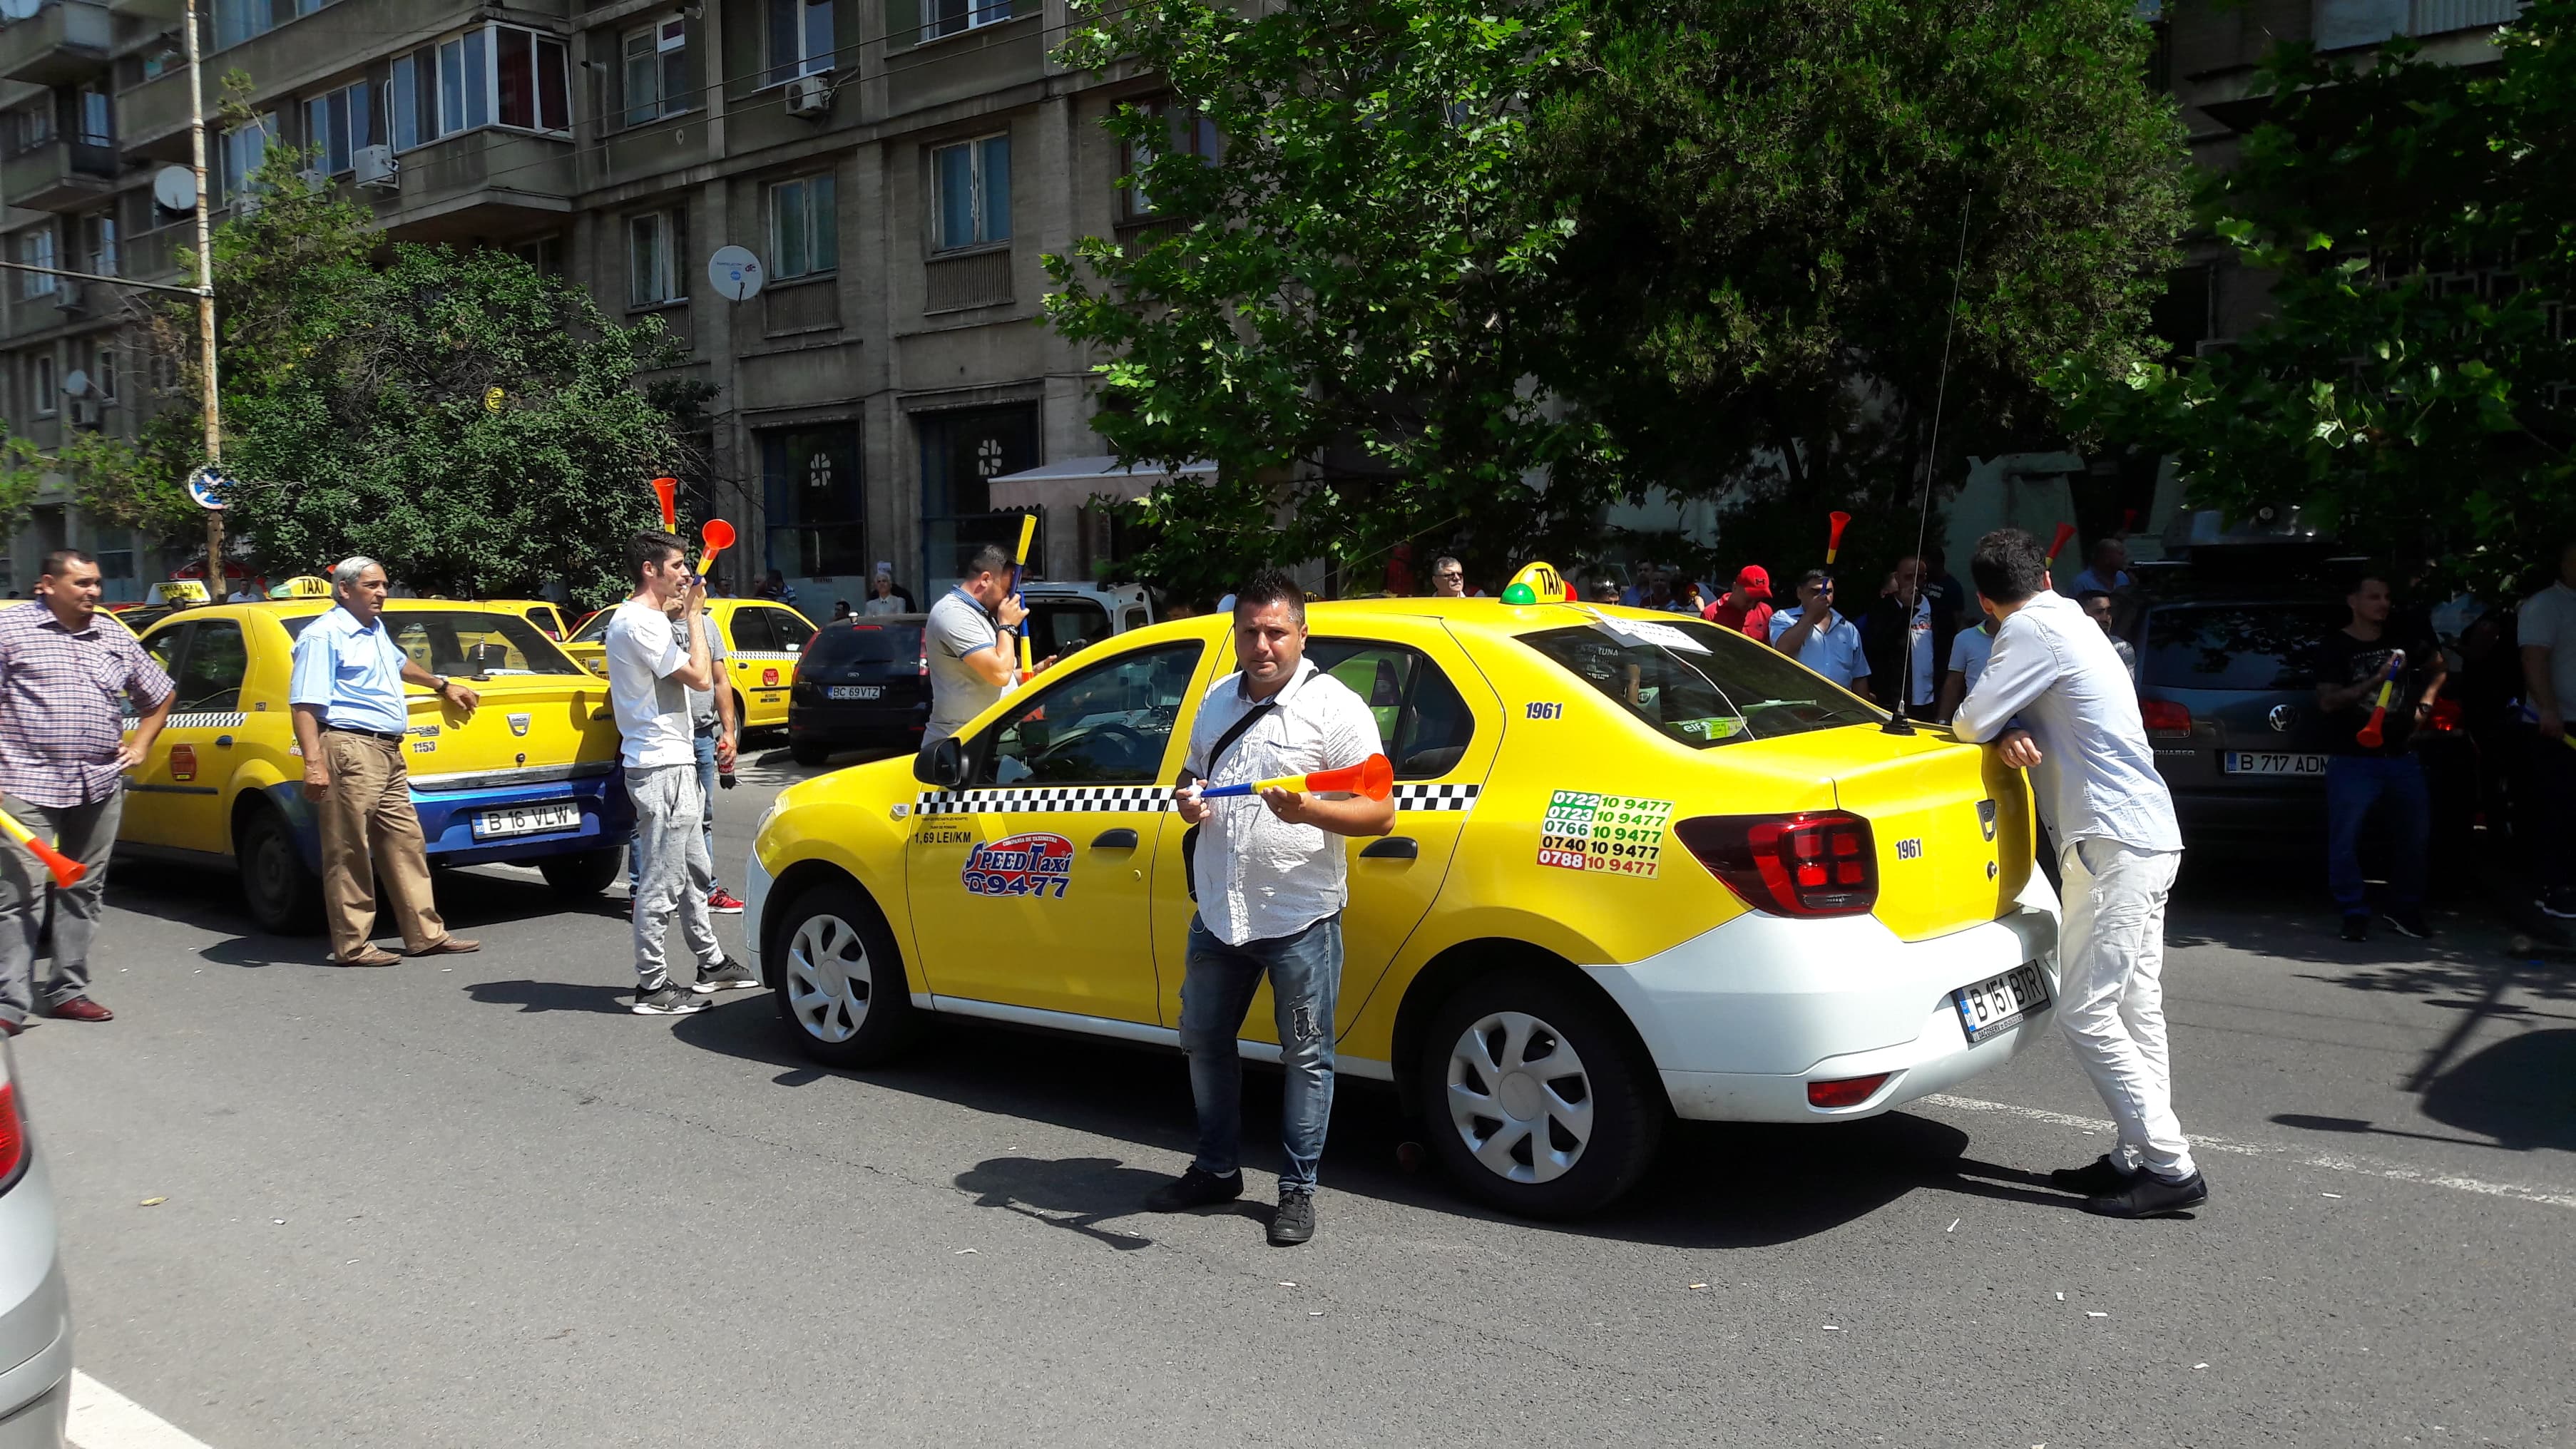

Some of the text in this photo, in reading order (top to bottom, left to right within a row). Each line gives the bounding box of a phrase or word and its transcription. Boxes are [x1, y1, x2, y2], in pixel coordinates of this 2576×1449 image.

[299, 578, 324, 594] TAXI
[1534, 567, 1564, 595] TAXI
[833, 687, 847, 697] BC
[1525, 702, 1563, 720] 1961
[412, 741, 436, 753] 1153
[2241, 754, 2254, 771] B
[2261, 754, 2290, 772] 717
[1553, 792, 1672, 812] 0722 10 9477
[488, 806, 568, 831] B 16 VLW
[1548, 806, 1665, 826] 0723 10 9477
[915, 831, 971, 844] 1,69 LEI/KM
[1545, 821, 1662, 844] 0766 10 9477
[1543, 836, 1660, 860] 0740 10 9477
[1896, 838, 1922, 860] 1961
[1539, 851, 1656, 875] 0788 10 9477
[986, 875, 1070, 898] 9477
[1970, 988, 1988, 1023] B
[1985, 978, 2013, 1015] 151
[2008, 966, 2042, 1005] BTR
